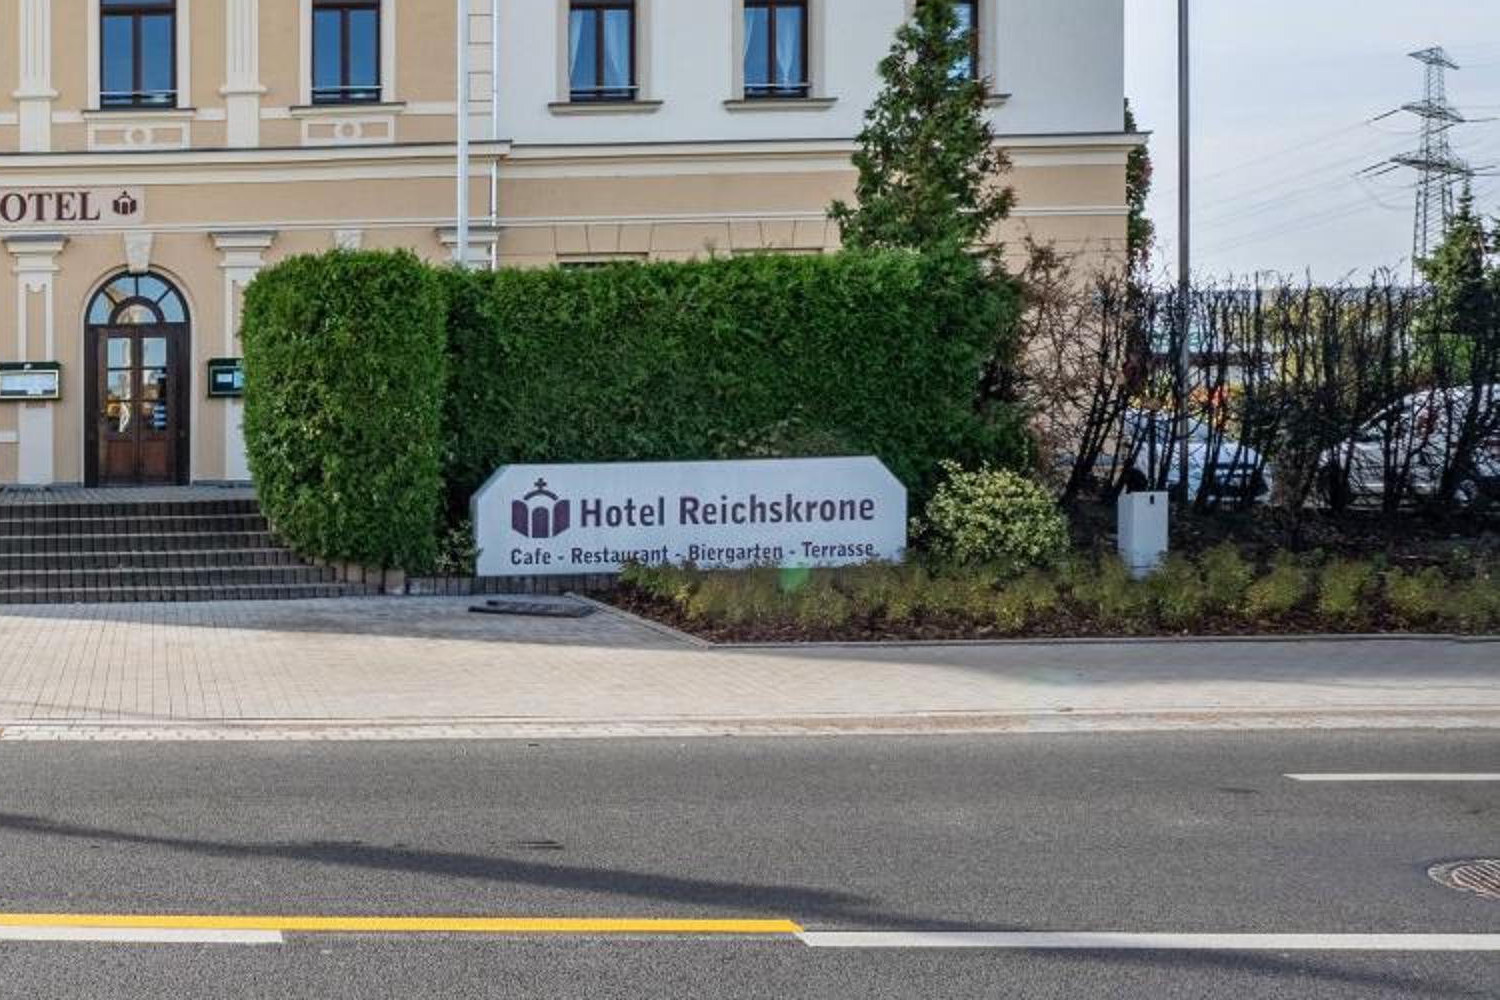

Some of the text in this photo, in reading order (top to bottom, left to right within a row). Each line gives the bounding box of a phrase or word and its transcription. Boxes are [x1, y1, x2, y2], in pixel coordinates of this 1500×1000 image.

[580, 492, 875, 527] Hotel Reichskrone
[511, 547, 551, 565] Cafe
[571, 545, 669, 564] Restaurant
[688, 542, 783, 563] Biergarten
[802, 541, 875, 558] Terrasse
